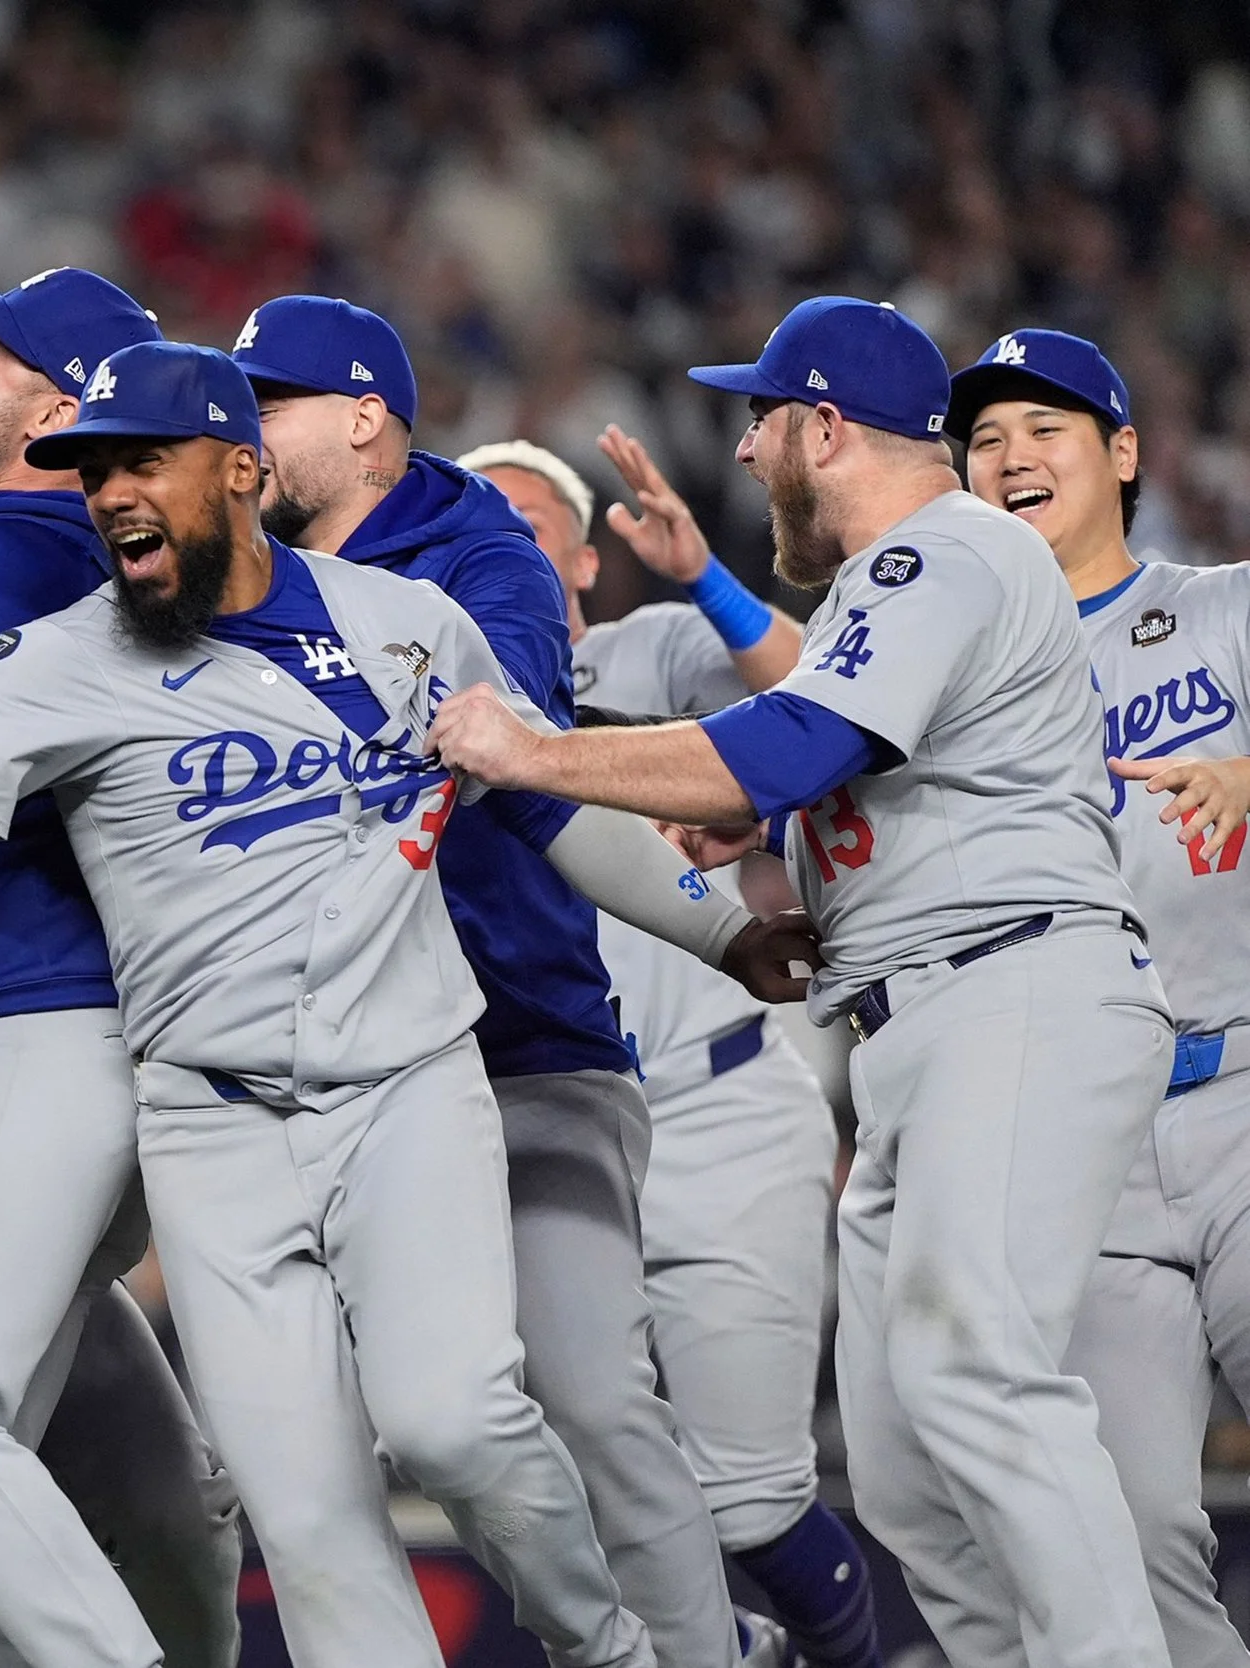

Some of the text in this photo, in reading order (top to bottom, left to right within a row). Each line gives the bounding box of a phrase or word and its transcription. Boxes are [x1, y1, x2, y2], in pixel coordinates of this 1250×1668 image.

[992, 333, 1026, 365] LA
[876, 560, 912, 582] 34
[883, 552, 917, 563] FERNANDO
[288, 633, 359, 681] LA
[814, 608, 874, 680] LA
[1104, 667, 1222, 818] gers
[799, 784, 875, 884] 13
[679, 868, 710, 900] 37
